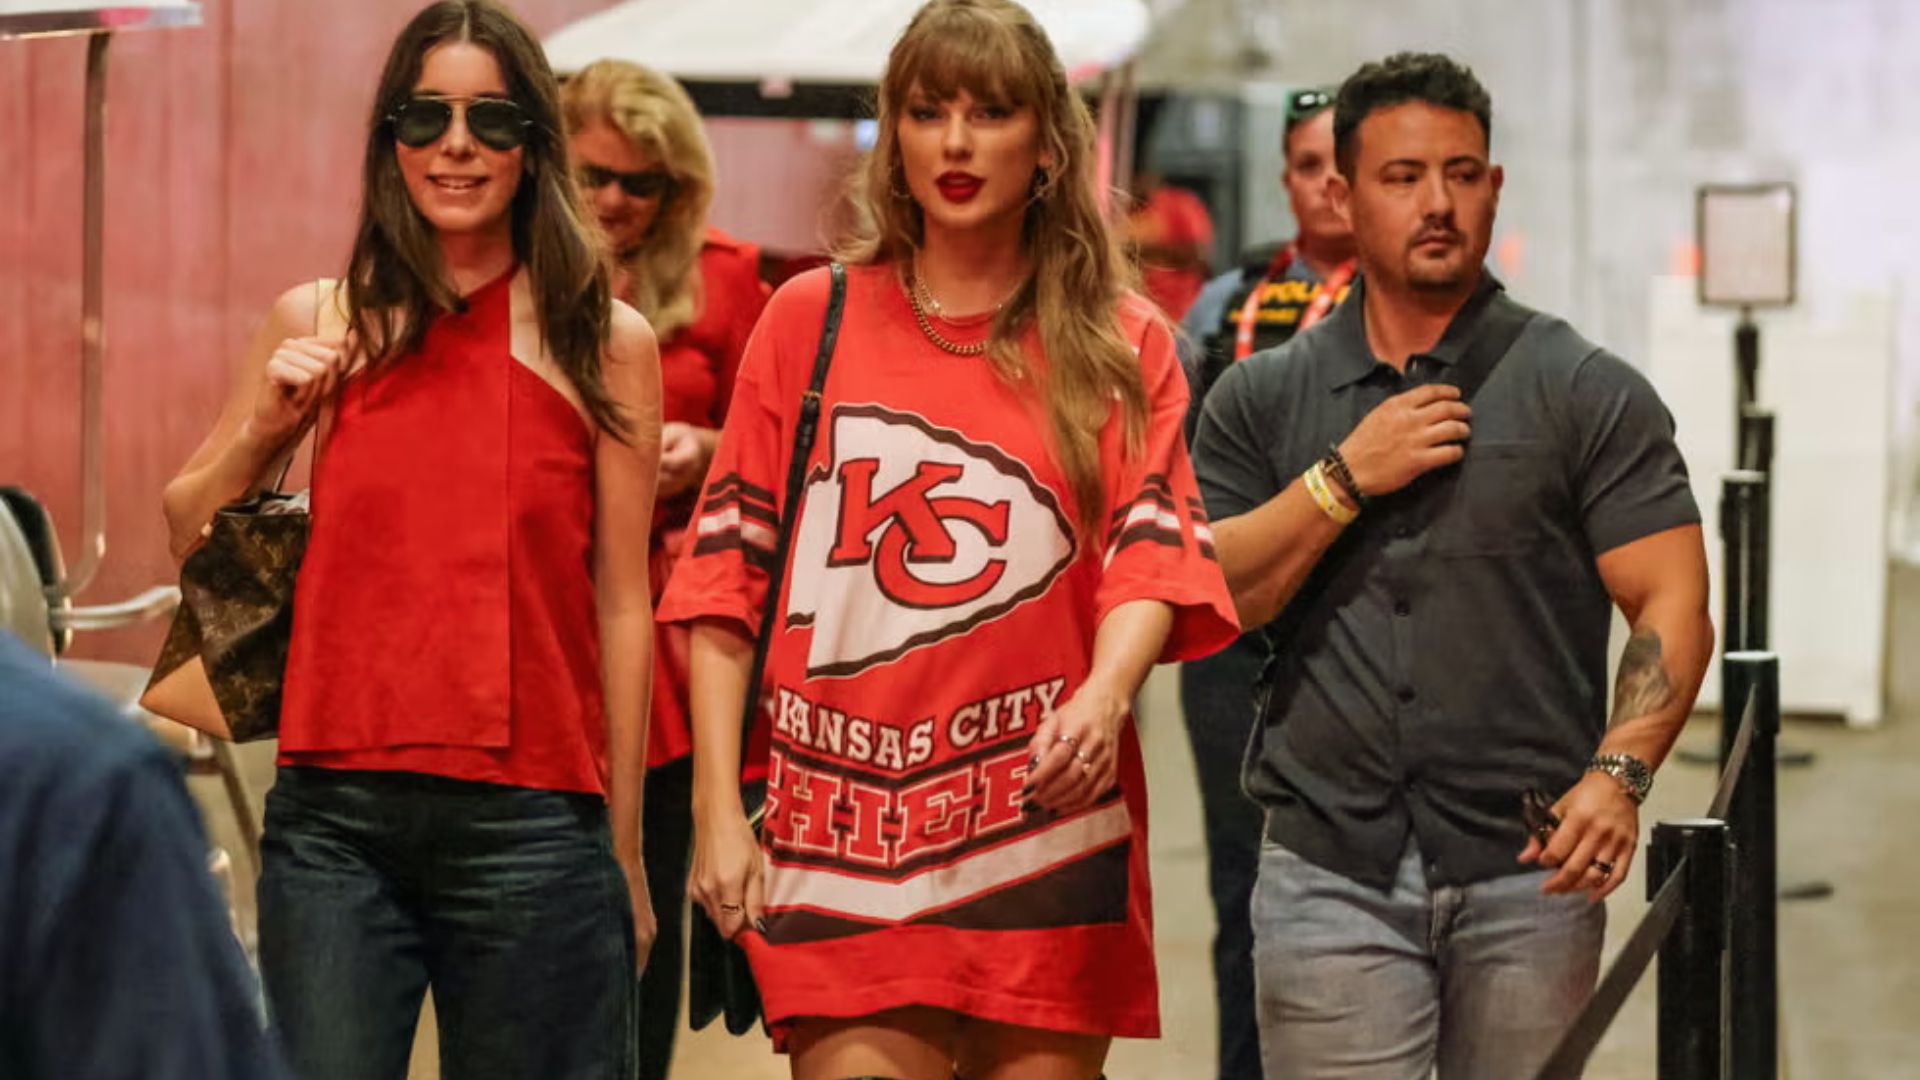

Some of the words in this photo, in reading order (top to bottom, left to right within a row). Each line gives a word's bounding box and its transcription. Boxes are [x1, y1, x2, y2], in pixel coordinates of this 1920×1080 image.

[827, 457, 1010, 609] KC
[776, 687, 934, 768] KANSAS
[949, 677, 1065, 746] CITY
[766, 749, 1030, 864] HIEF
